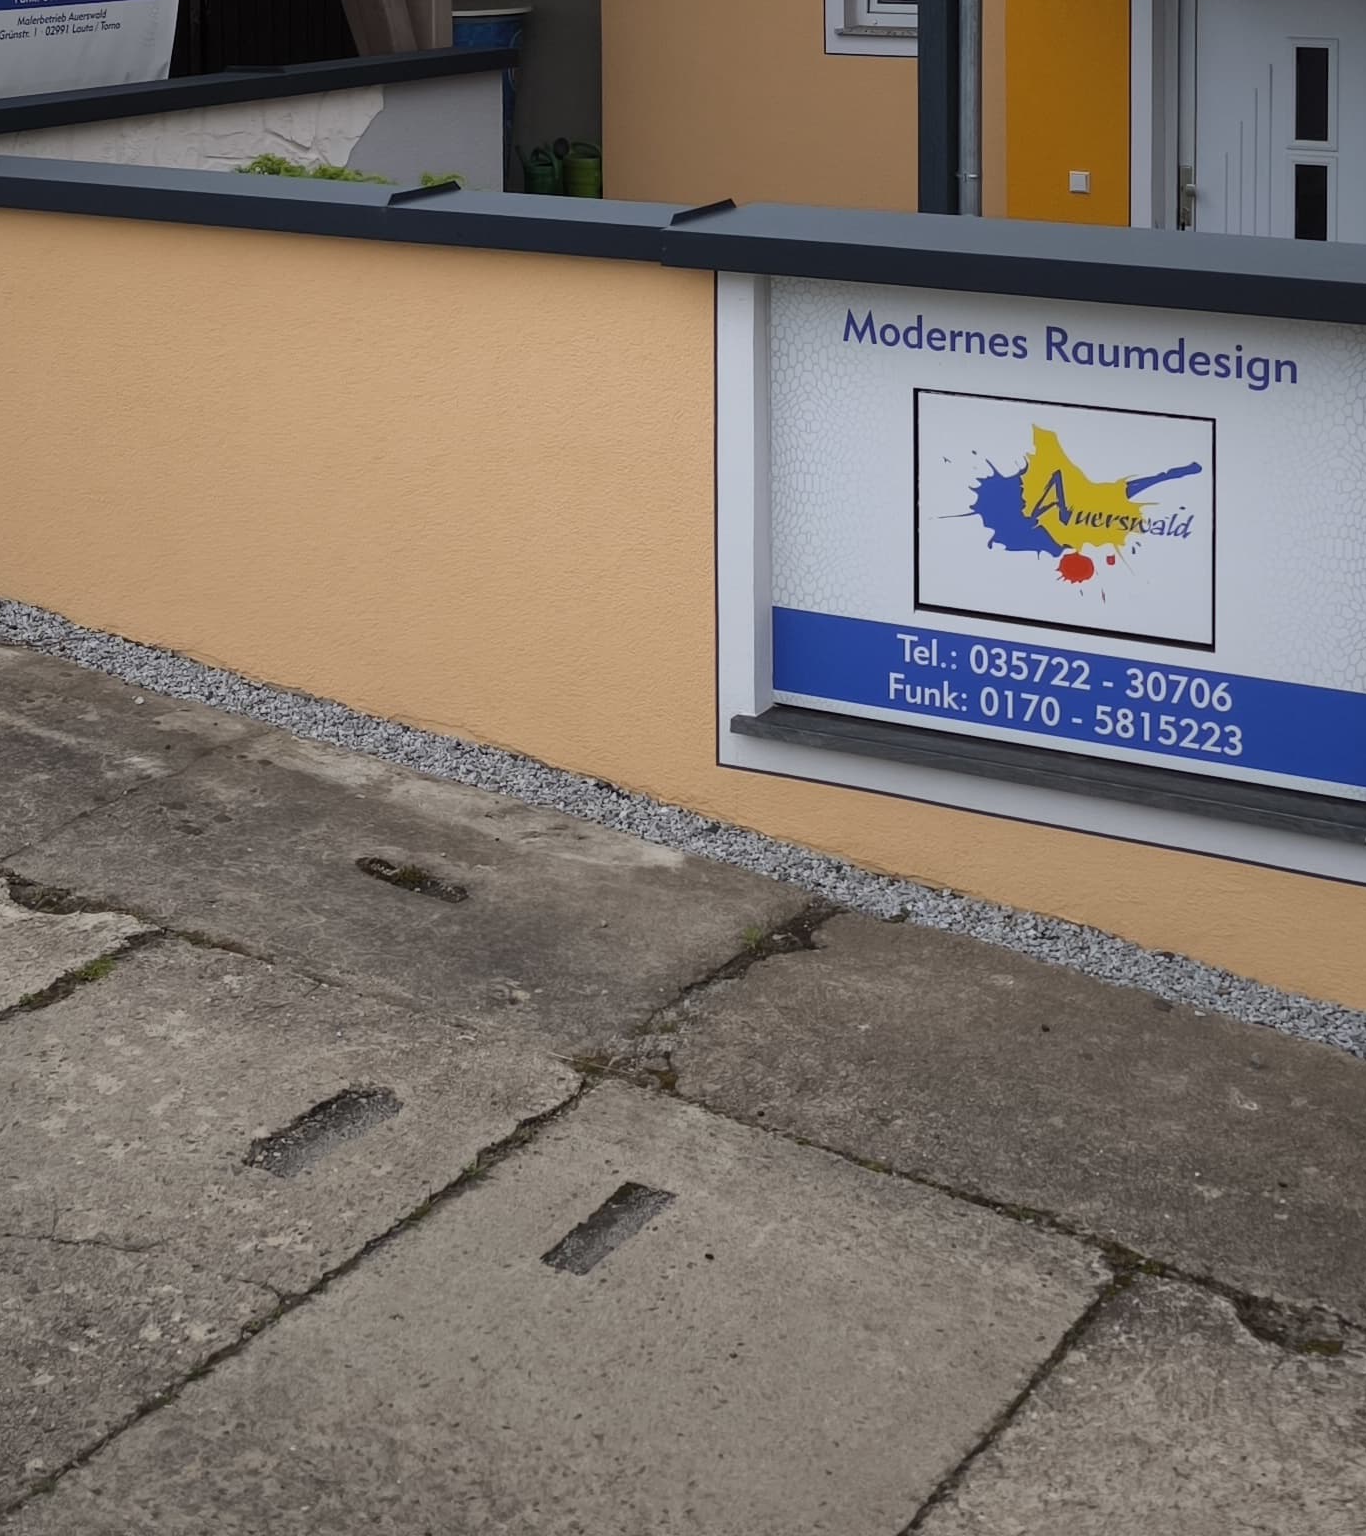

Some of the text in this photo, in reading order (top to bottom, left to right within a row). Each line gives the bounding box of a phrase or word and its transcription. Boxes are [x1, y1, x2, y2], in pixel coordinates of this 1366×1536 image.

[17, 9, 108, 27] Malerbetrieb Auerswald
[45, 24, 70, 36] 02991
[843, 308, 1298, 391] Modernes Raumdesign
[1031, 468, 1195, 539] Auerswald
[896, 633, 957, 670] Tel.:
[969, 644, 1091, 691] 035722
[1125, 667, 1233, 713] 30706
[889, 672, 968, 713] Funk:
[980, 686, 1061, 727] 0170
[1094, 705, 1244, 757] 5815223
